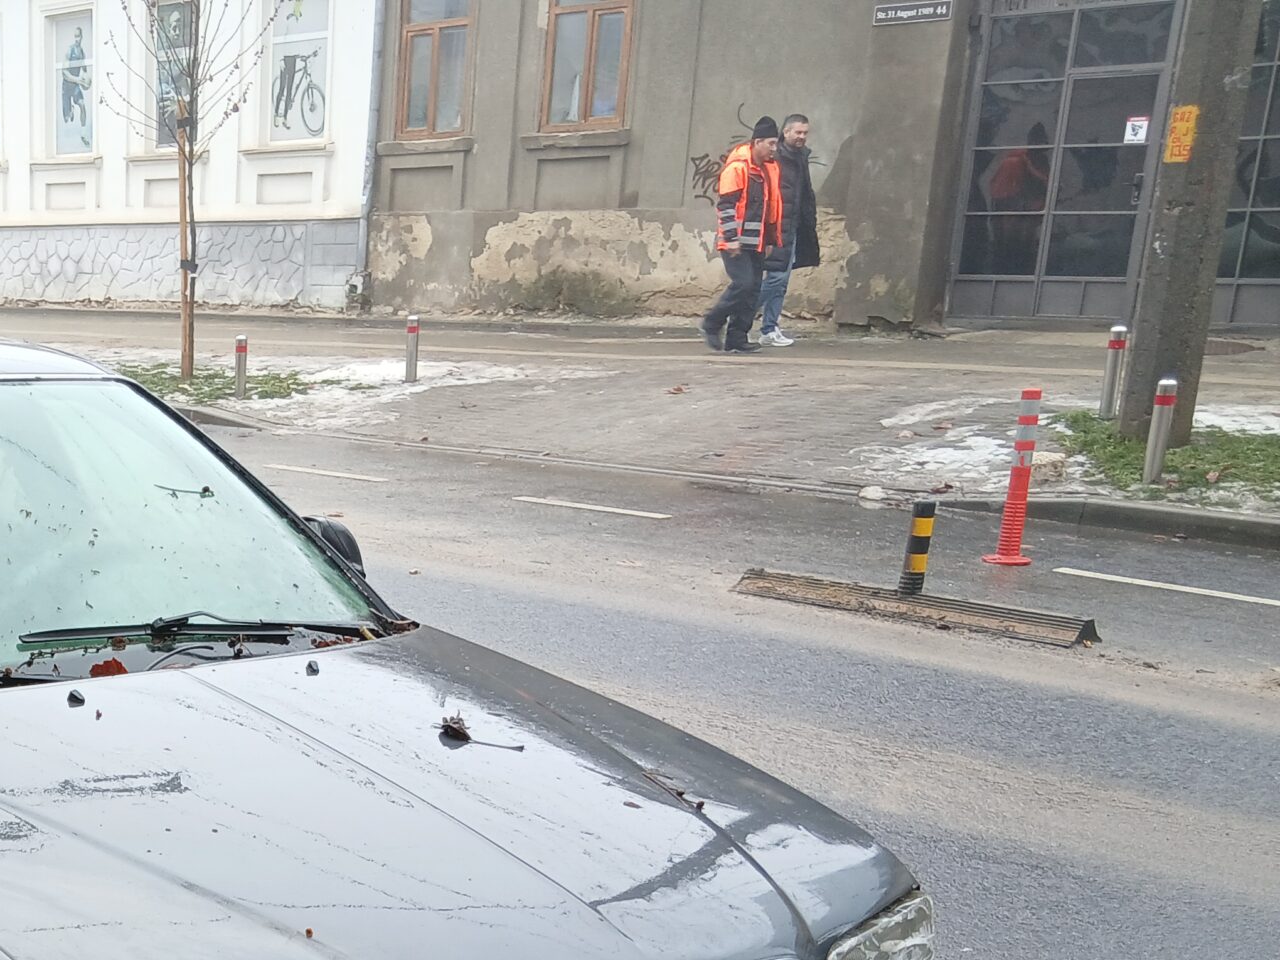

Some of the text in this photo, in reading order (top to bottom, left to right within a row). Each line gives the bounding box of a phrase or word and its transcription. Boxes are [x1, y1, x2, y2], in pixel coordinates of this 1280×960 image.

[887, 10, 896, 18] 31
[896, 9, 917, 18] August
[918, 7, 935, 15] 1989
[936, 5, 947, 15] 44
[1173, 111, 1193, 123] GAZ
